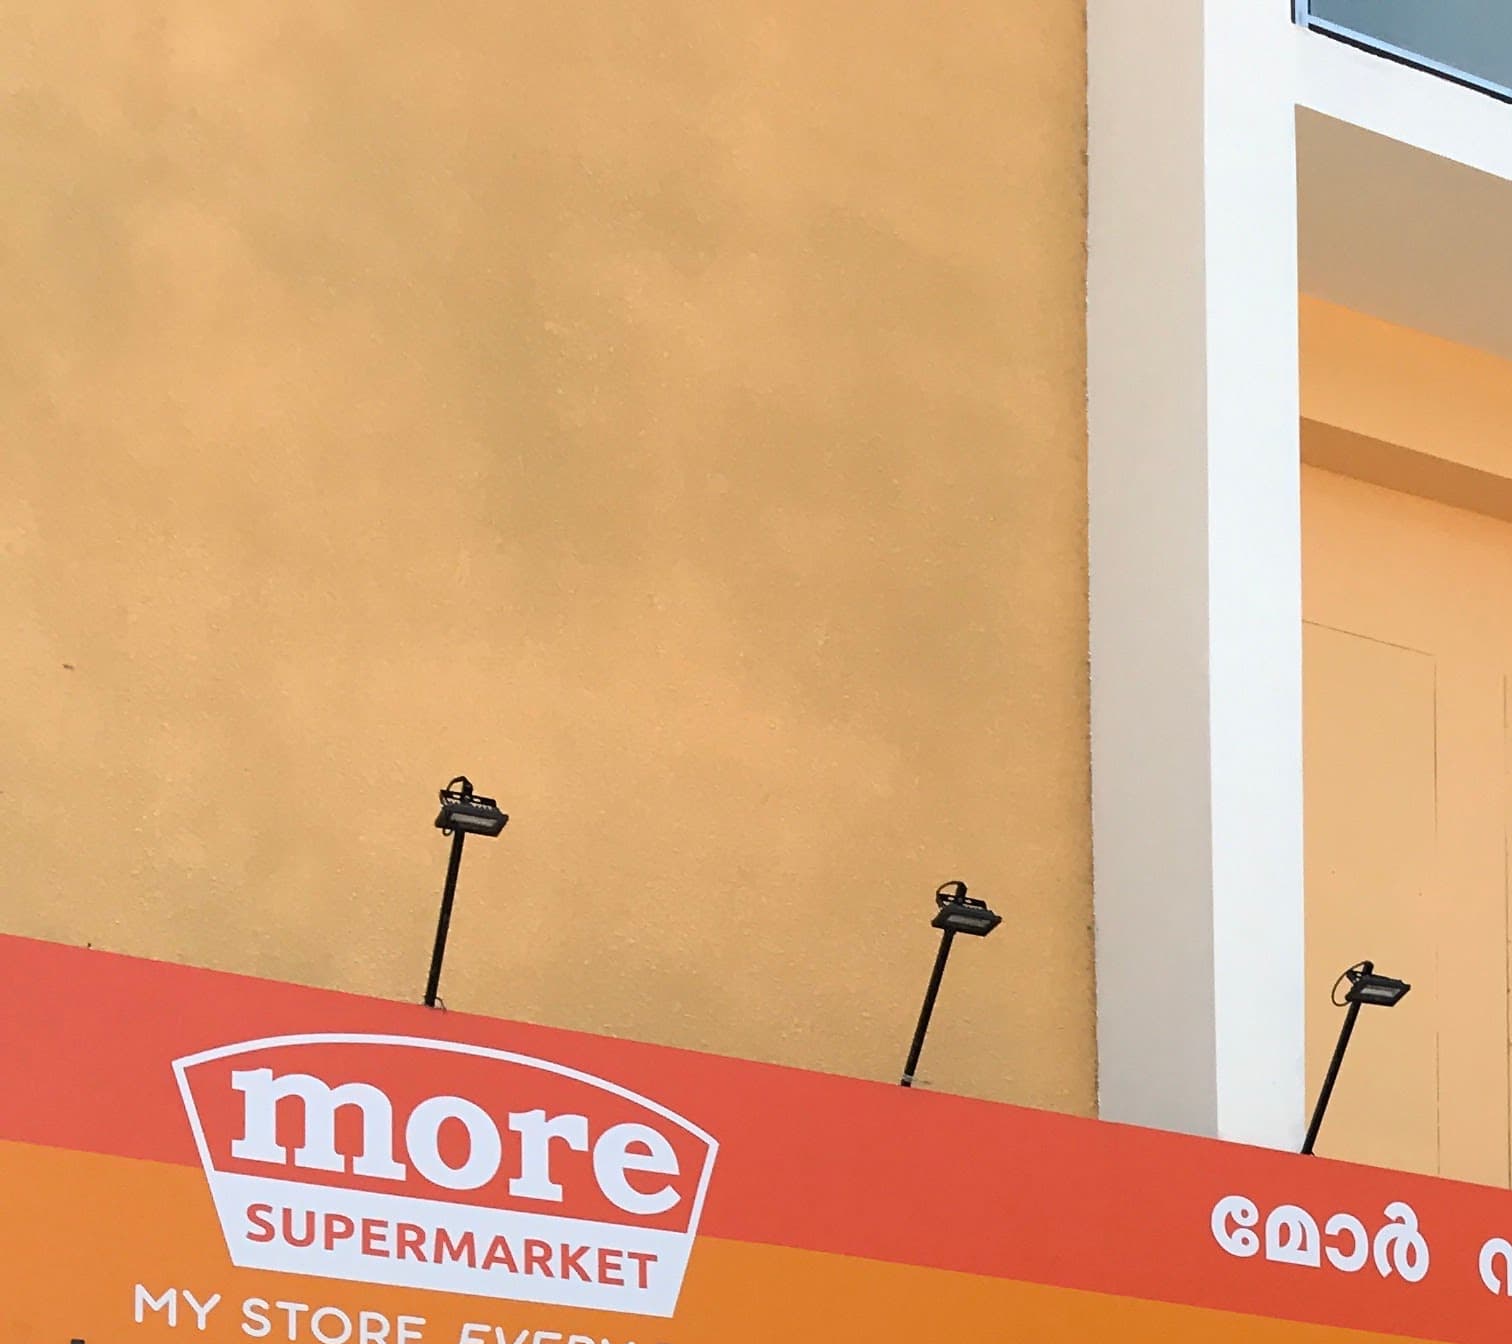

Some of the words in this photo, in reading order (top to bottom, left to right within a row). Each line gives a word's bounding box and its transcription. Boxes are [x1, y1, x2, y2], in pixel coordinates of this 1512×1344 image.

[231, 1067, 682, 1214] more
[245, 1203, 658, 1290] SUPERMARKET
[1211, 1195, 1430, 1283] മോർ
[134, 1284, 222, 1330] MY
